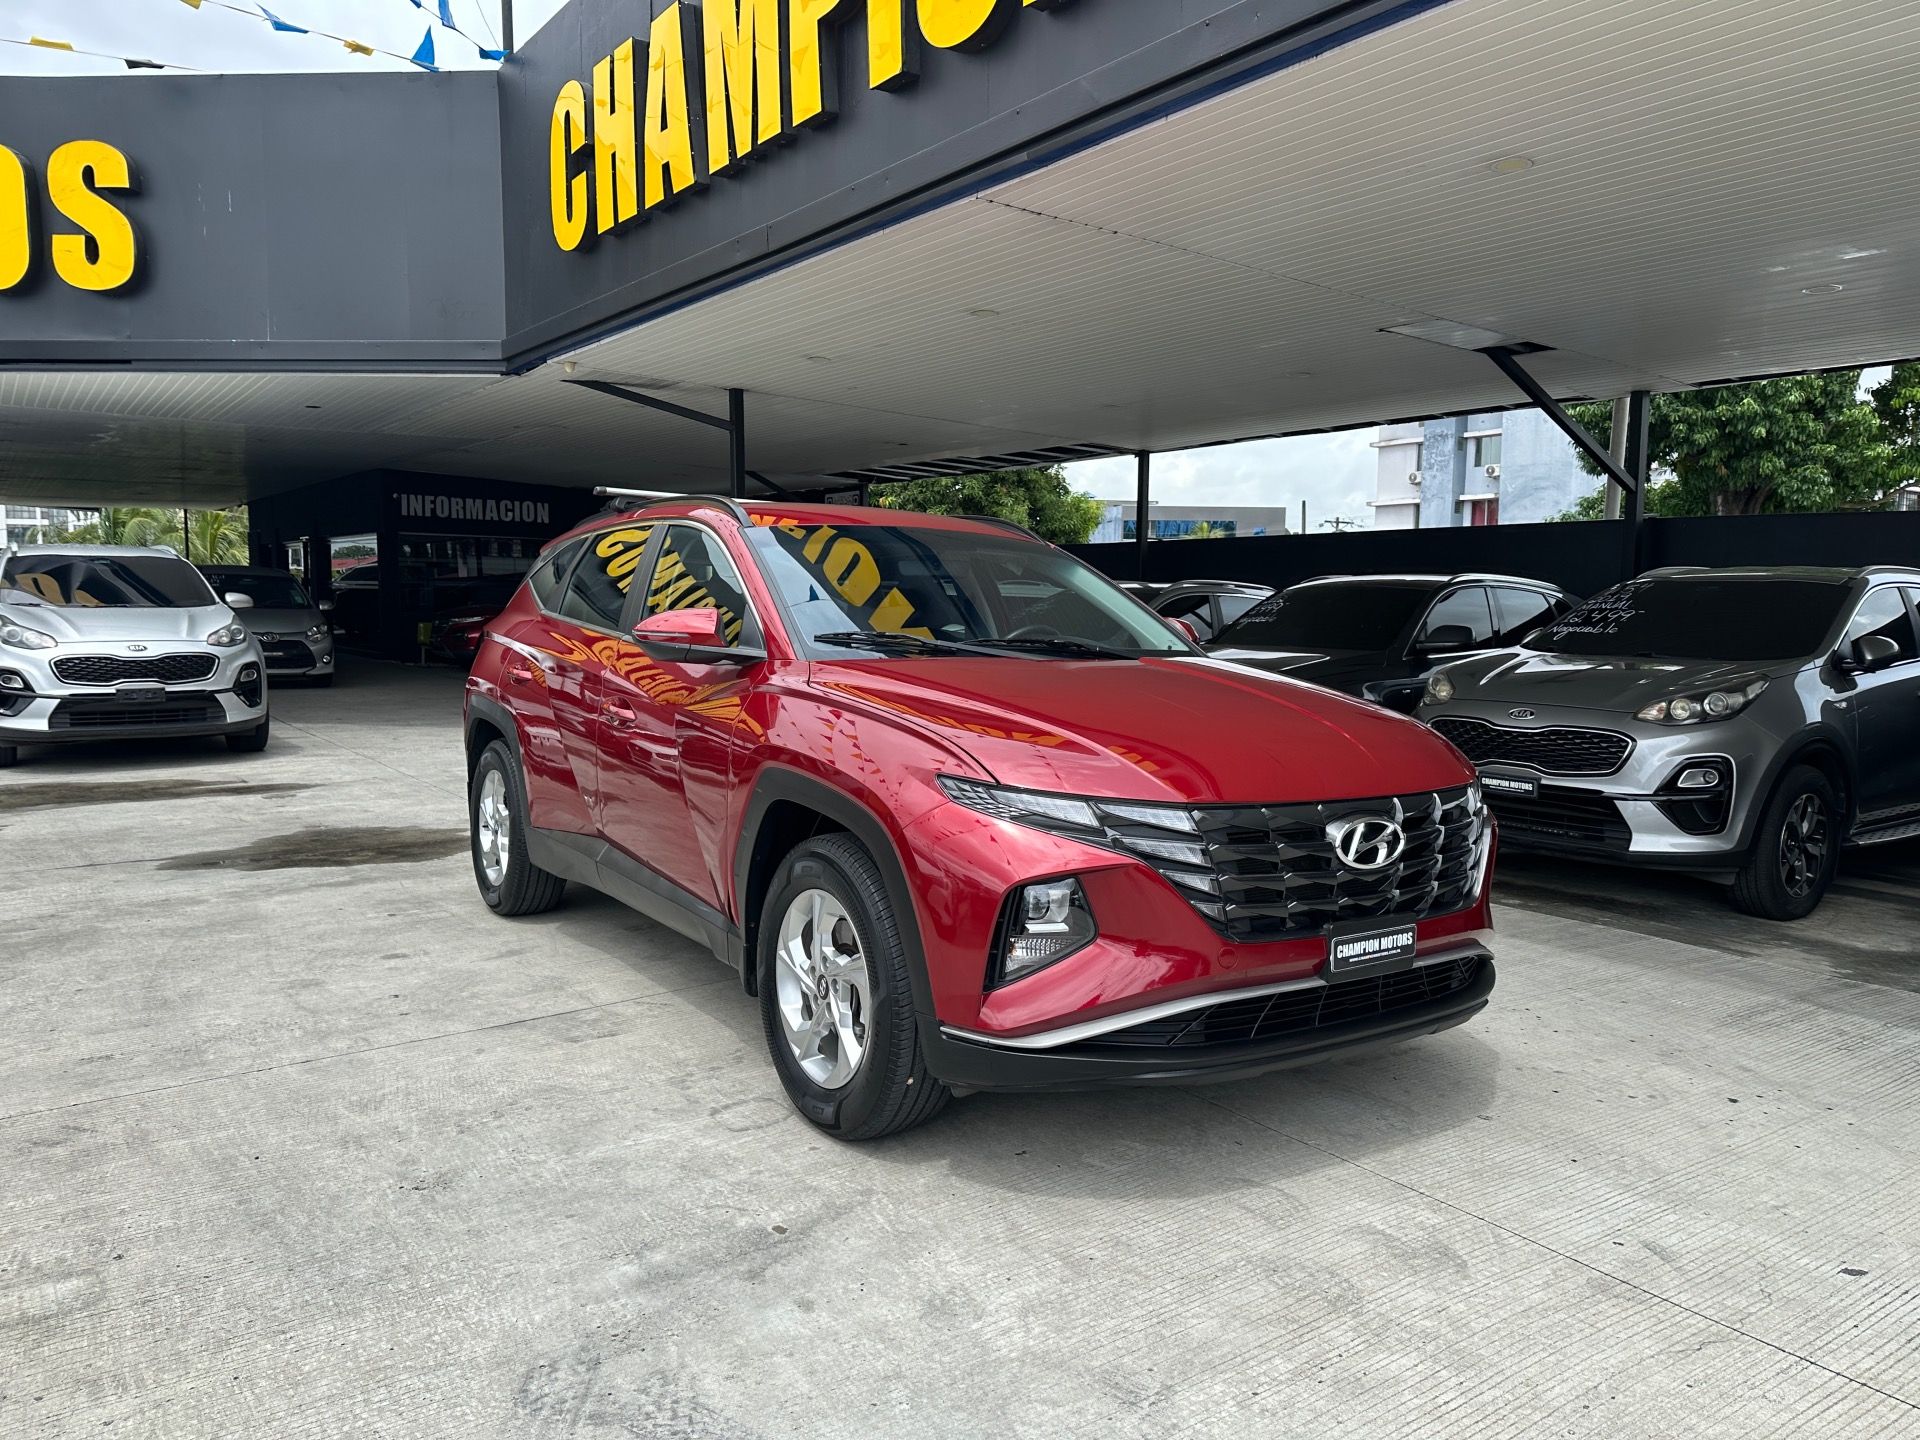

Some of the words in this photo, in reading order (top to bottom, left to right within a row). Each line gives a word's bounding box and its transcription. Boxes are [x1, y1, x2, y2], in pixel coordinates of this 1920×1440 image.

[550, 0, 1037, 252] CHAMP
[401, 493, 550, 524] INFORMACION
[1481, 777, 1509, 787] CHAMPION
[1510, 781, 1533, 790] MOTORS
[1337, 938, 1379, 958] CHAMPION
[1381, 932, 1413, 950] MOTORS
